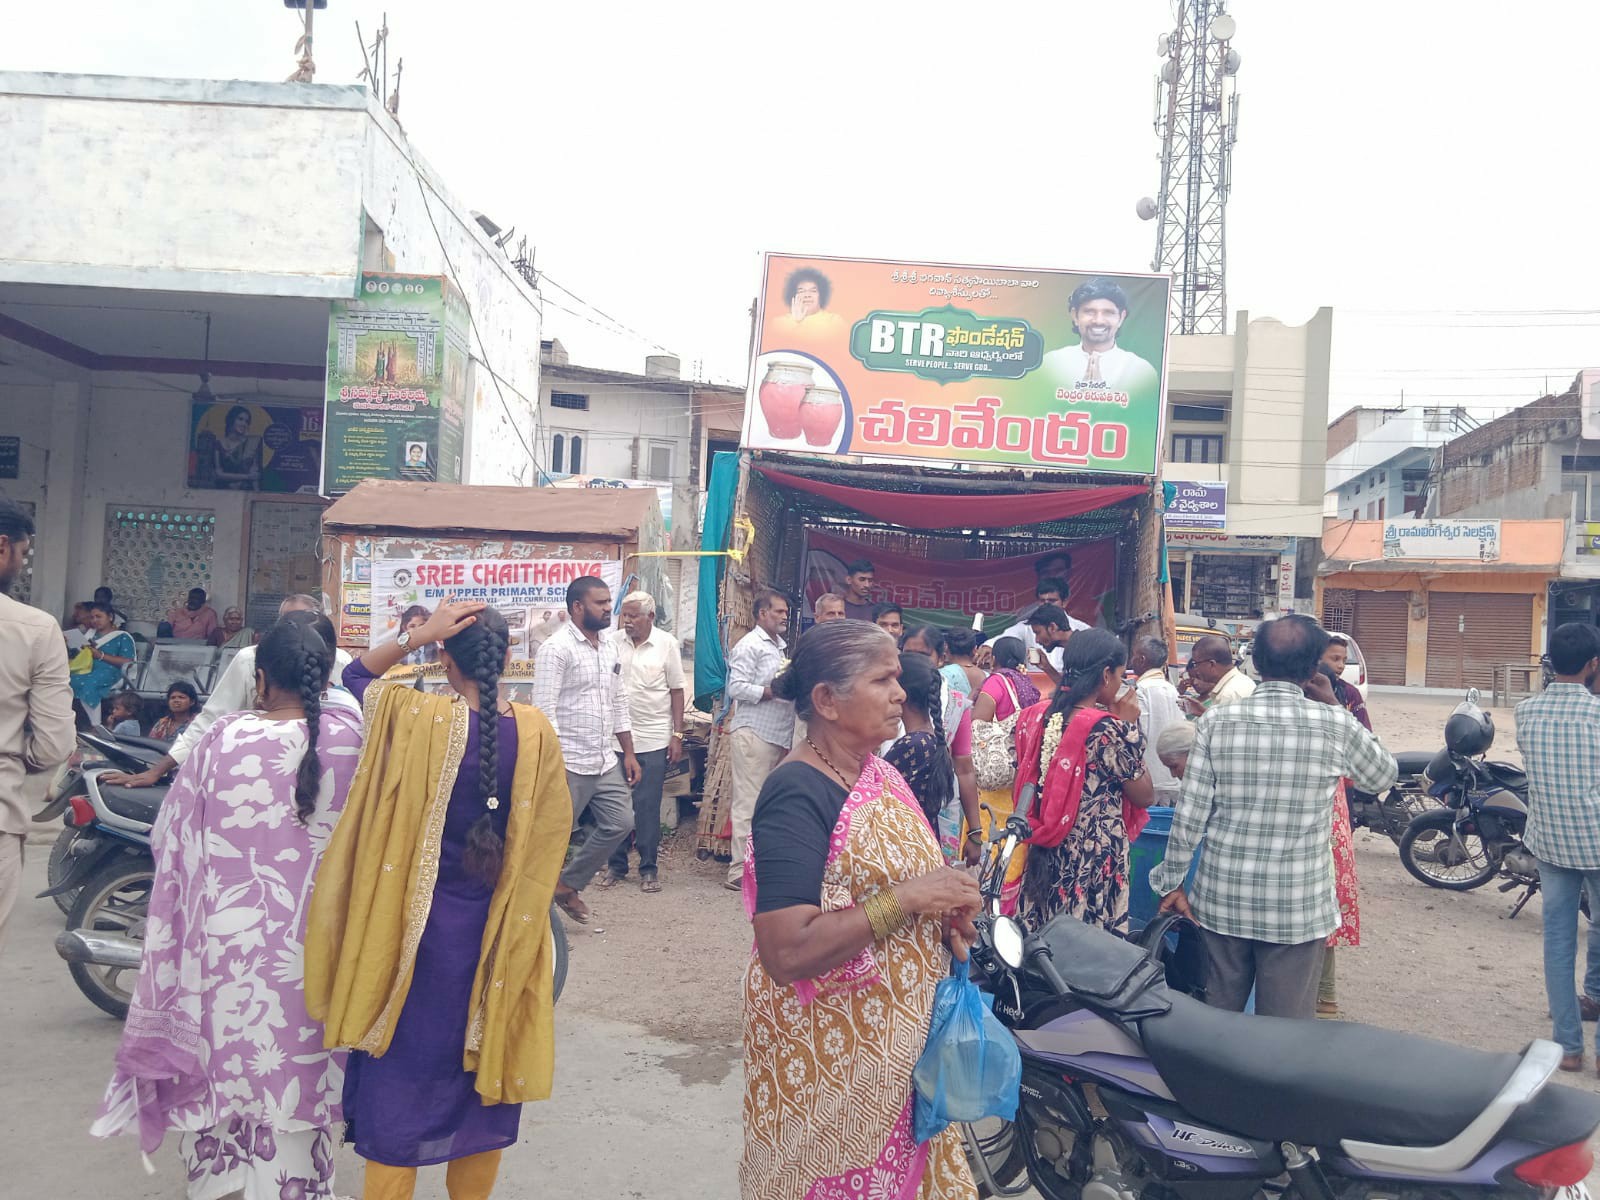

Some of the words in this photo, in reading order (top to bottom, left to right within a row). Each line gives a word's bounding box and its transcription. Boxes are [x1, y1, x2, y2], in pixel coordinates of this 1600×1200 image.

[870, 319, 945, 357] BTR
[905, 359, 926, 368] SERVE
[954, 362, 974, 370] SERVE
[859, 398, 1127, 465] చలివేంద్రం
[416, 564, 464, 586] SREE
[472, 563, 601, 587] CHAITHANYA
[425, 589, 444, 598] E/M
[449, 588, 487, 597] UPPER
[491, 587, 543, 597] PRIMARY
[546, 587, 567, 596] SCH
[1172, 1129, 1198, 1141] HF
